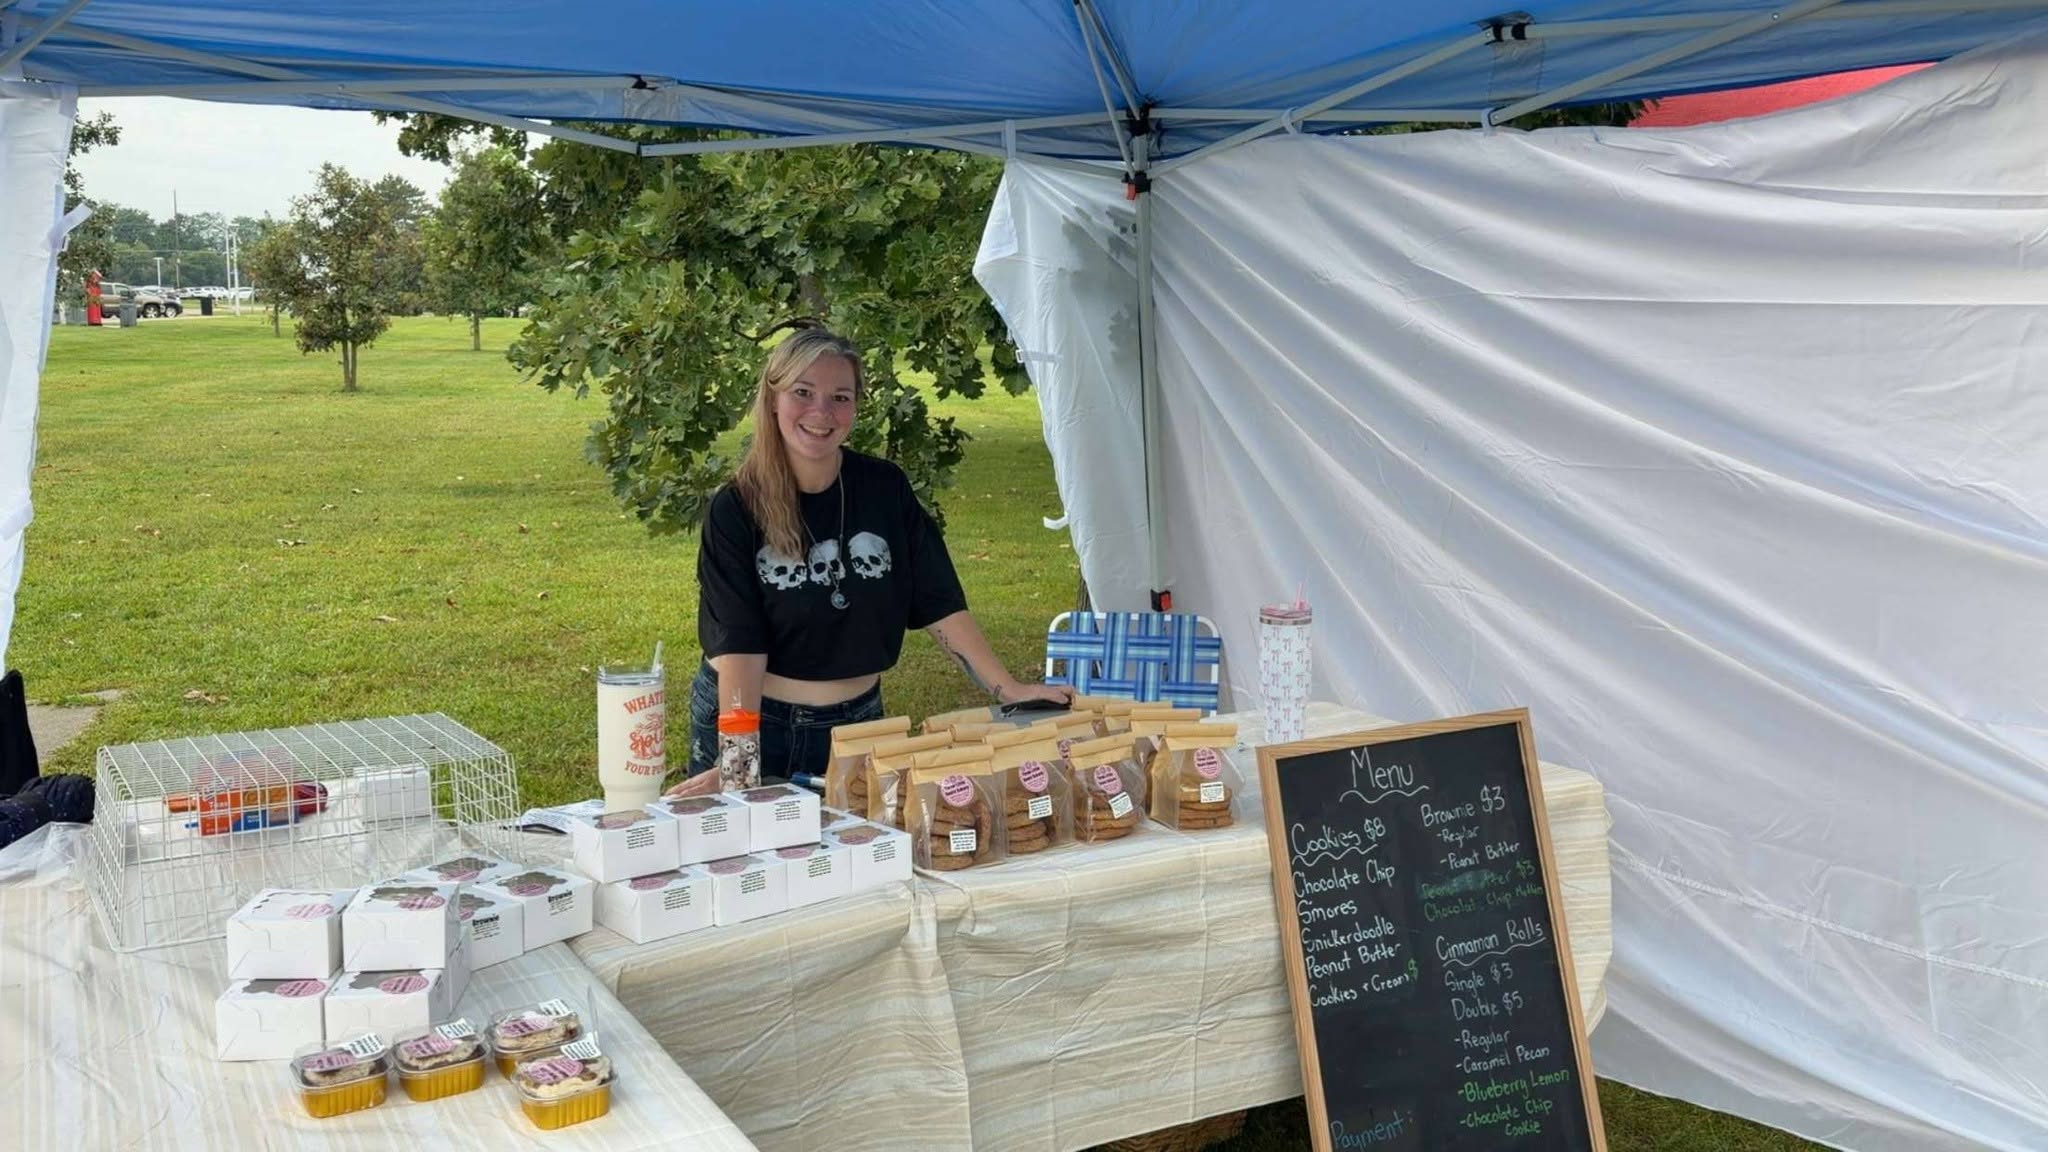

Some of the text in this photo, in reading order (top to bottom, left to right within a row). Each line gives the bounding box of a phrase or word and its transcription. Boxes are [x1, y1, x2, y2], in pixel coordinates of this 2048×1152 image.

[625, 760, 650, 776] YOUR
[1350, 746, 1413, 789] Menu
[1420, 785, 1506, 827] Brownie $3
[1291, 817, 1386, 855] Cookies $8
[1484, 840, 1520, 861] Butter
[1292, 859, 1396, 898] Chocolate Chip
[1515, 860, 1536, 880] $3
[1297, 899, 1358, 924] Smores
[1485, 892, 1513, 910] Chip
[1301, 915, 1396, 953] Snickerdoodle
[1435, 916, 1544, 961] Cinnamon Rolls
[1305, 943, 1402, 979] Peanut Butter
[1309, 981, 1358, 1007] Cookies
[1371, 973, 1410, 993] Cream
[1444, 961, 1513, 998] Single $3
[1451, 991, 1524, 1022] Double $5
[1515, 1044, 1550, 1063] Pecan
[1529, 1069, 1570, 1088] Lemon
[1525, 1098, 1553, 1116] Chip
[1505, 1120, 1542, 1137] Cookie
